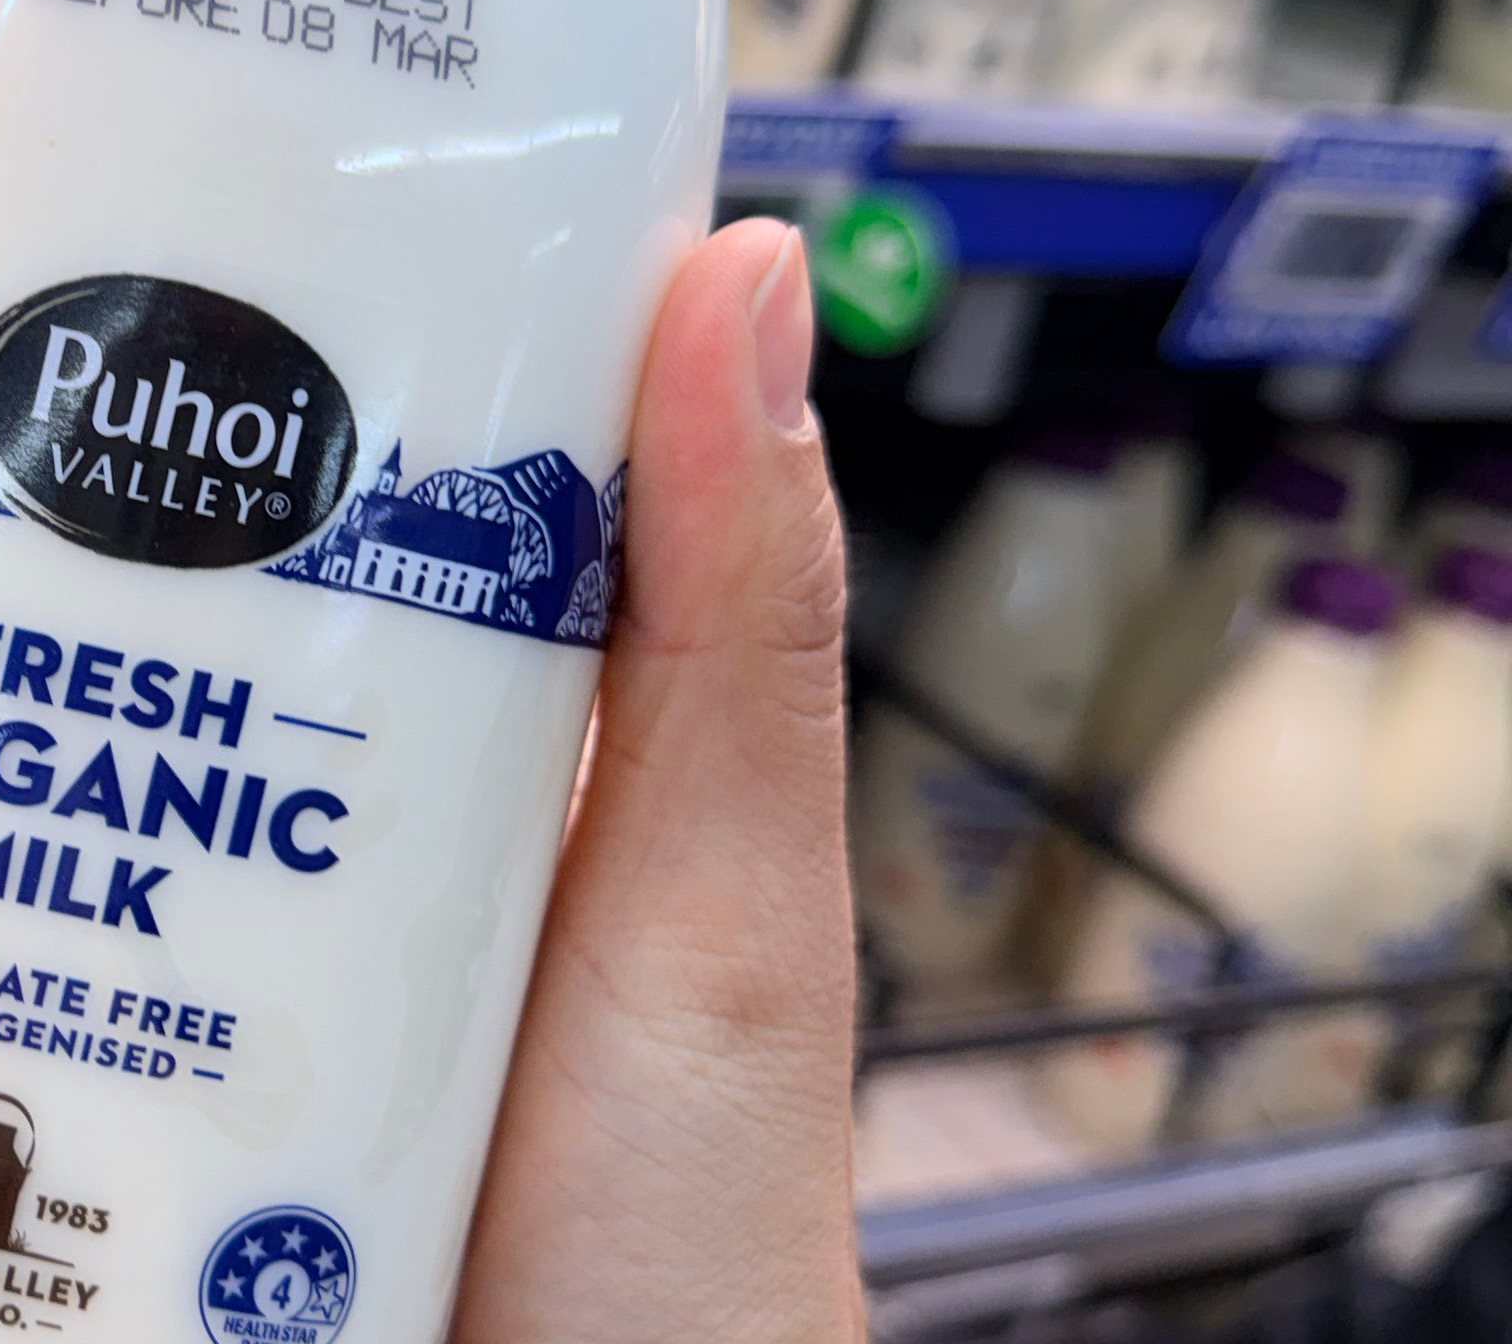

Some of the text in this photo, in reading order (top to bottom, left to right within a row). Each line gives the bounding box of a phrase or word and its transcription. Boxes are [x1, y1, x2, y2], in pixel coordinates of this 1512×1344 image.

[372, 18, 479, 90] MAR
[30, 323, 310, 480] Puhoi
[107, 987, 238, 1051] FREE
[35, 1193, 112, 1235] 1983
[270, 1273, 293, 1311] 4
[223, 1315, 318, 1344] HEALTH STAR
